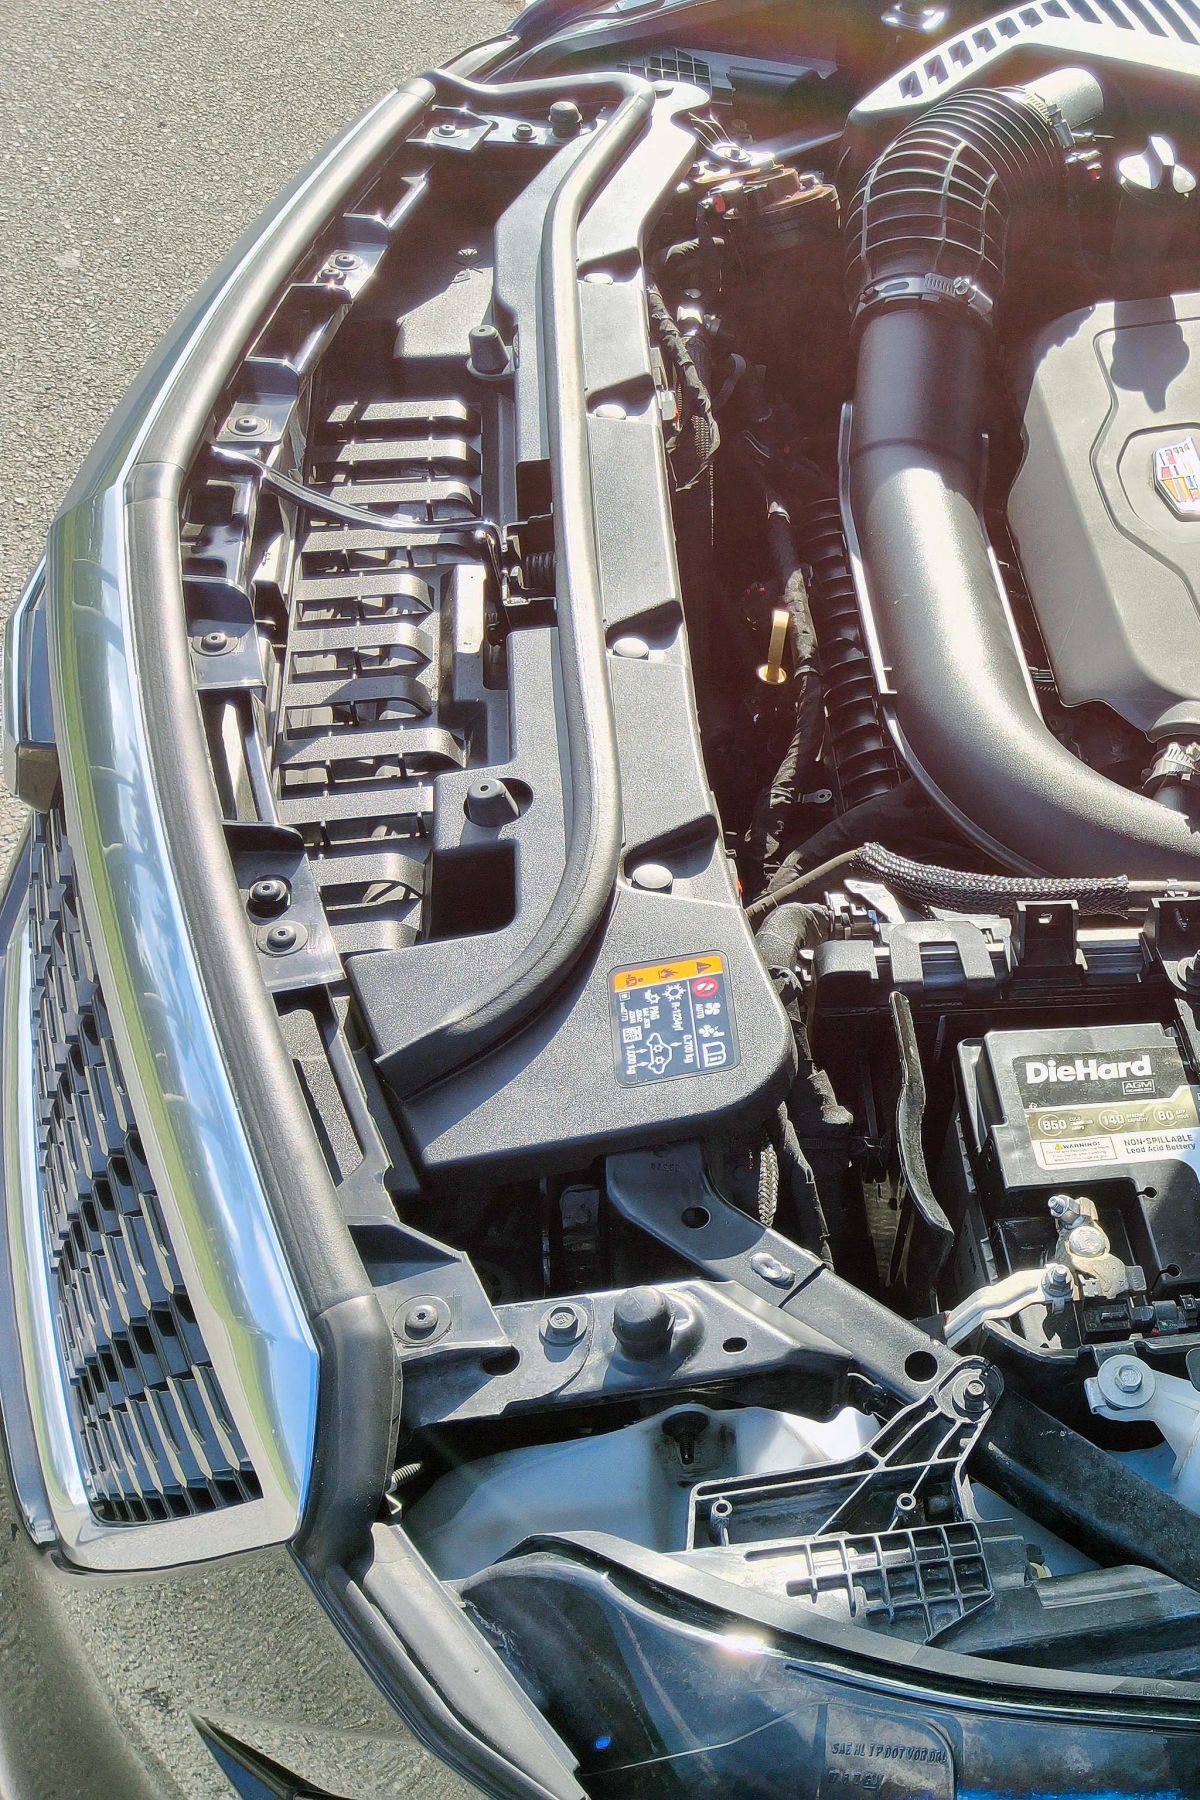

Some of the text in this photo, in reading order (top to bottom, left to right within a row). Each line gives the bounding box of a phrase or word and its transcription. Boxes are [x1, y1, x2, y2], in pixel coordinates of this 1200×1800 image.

[1025, 1055, 1153, 1084] DieHard
[1125, 1081, 1152, 1089] AGM
[1102, 1114, 1125, 1125] 140
[1158, 1110, 1175, 1121] 80
[1043, 1119, 1067, 1131] 850
[1124, 1134, 1194, 1146] NON-SPILLABLE
[1126, 1142, 1197, 1155] Lead Acid Battery
[885, 1745, 906, 1759] DOT
